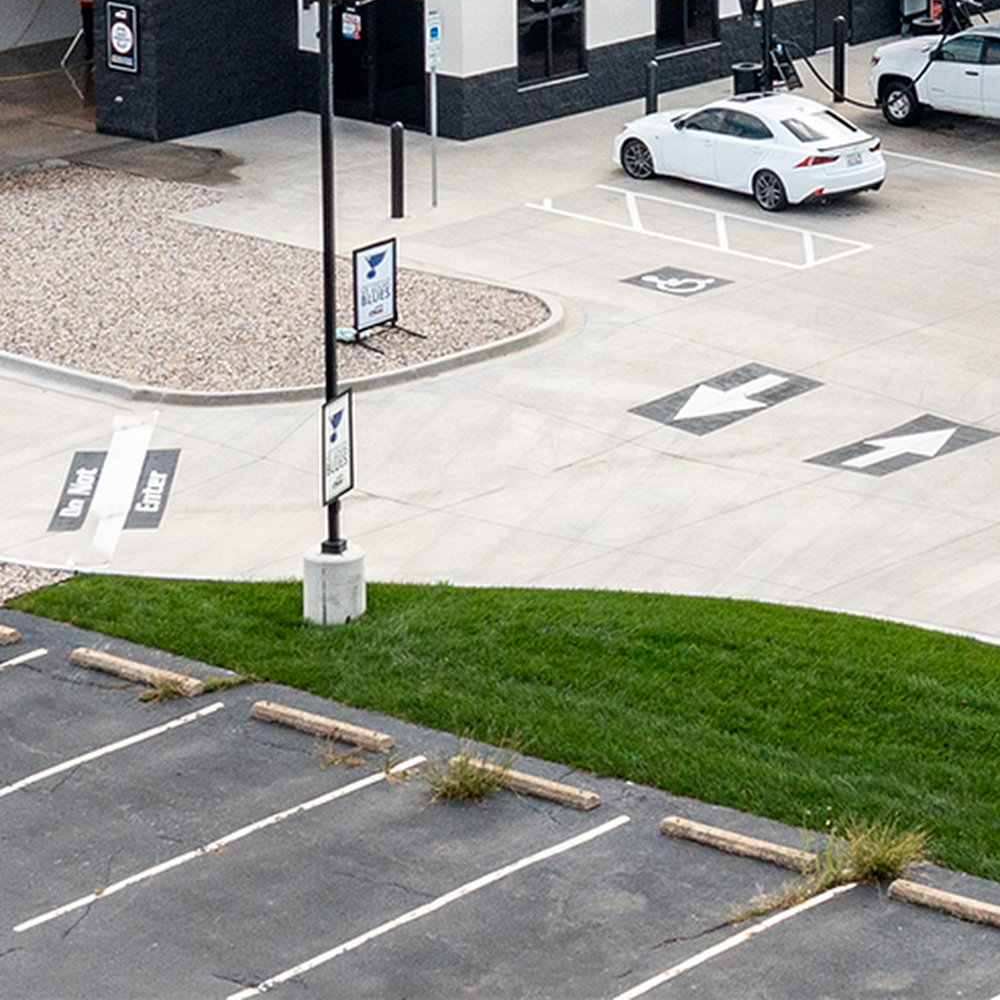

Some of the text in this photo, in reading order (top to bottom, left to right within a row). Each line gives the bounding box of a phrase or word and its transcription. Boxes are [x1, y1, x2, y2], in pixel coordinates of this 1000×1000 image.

[58, 467, 98, 518] Do Not
[134, 470, 168, 512] Enter
